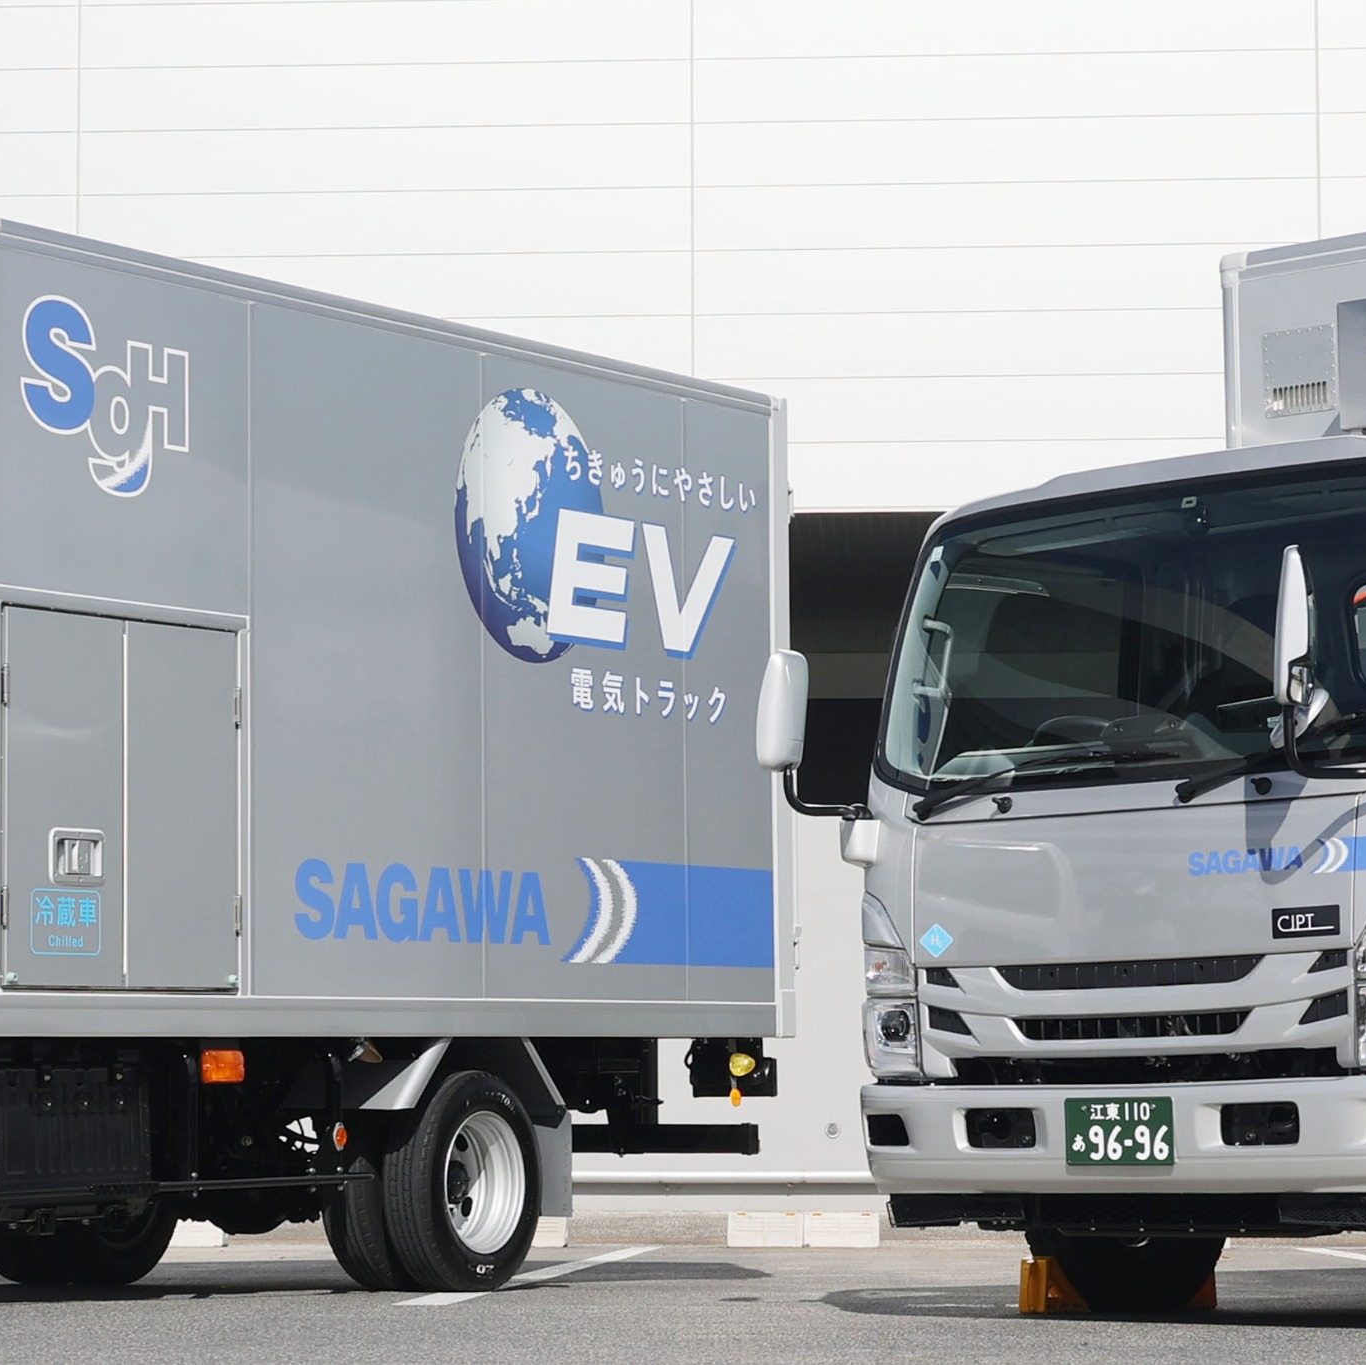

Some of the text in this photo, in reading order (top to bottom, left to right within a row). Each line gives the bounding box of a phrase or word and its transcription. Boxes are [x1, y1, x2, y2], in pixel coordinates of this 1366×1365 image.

[563, 445, 757, 512] ちきゅうにやさしい
[546, 508, 736, 660] EV
[570, 667, 727, 724] 電気トラック
[1188, 846, 1304, 876] SAGAWA
[35, 895, 97, 928] 冷蔵車
[294, 858, 552, 946] SAGAWA
[48, 934, 84, 948] Chilled
[1089, 1101, 1151, 1121] 江東 110
[1072, 1124, 1170, 1161] あ 96-96
